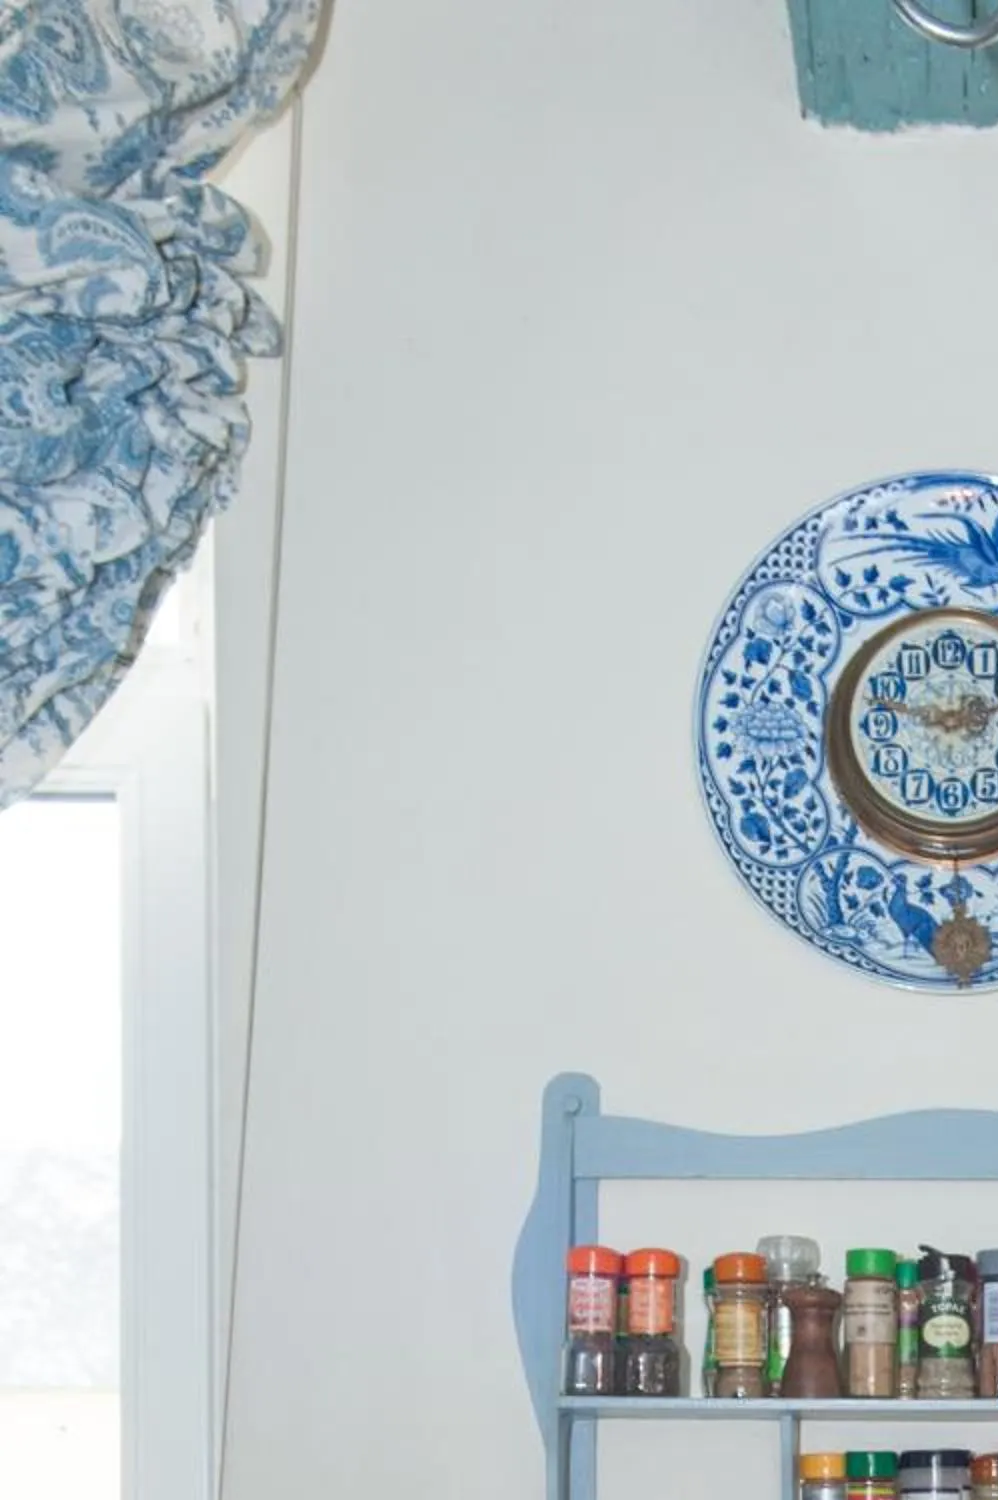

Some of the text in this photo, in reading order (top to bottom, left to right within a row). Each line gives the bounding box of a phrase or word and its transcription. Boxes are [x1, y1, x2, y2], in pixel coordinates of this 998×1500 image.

[907, 653, 923, 675] 11
[939, 640, 960, 664] 12
[876, 676, 898, 700] 10
[873, 713, 889, 738] 9
[884, 751, 898, 774] 8
[911, 774, 925, 798] 7
[943, 784, 958, 810] 6
[981, 773, 996, 797] 5
